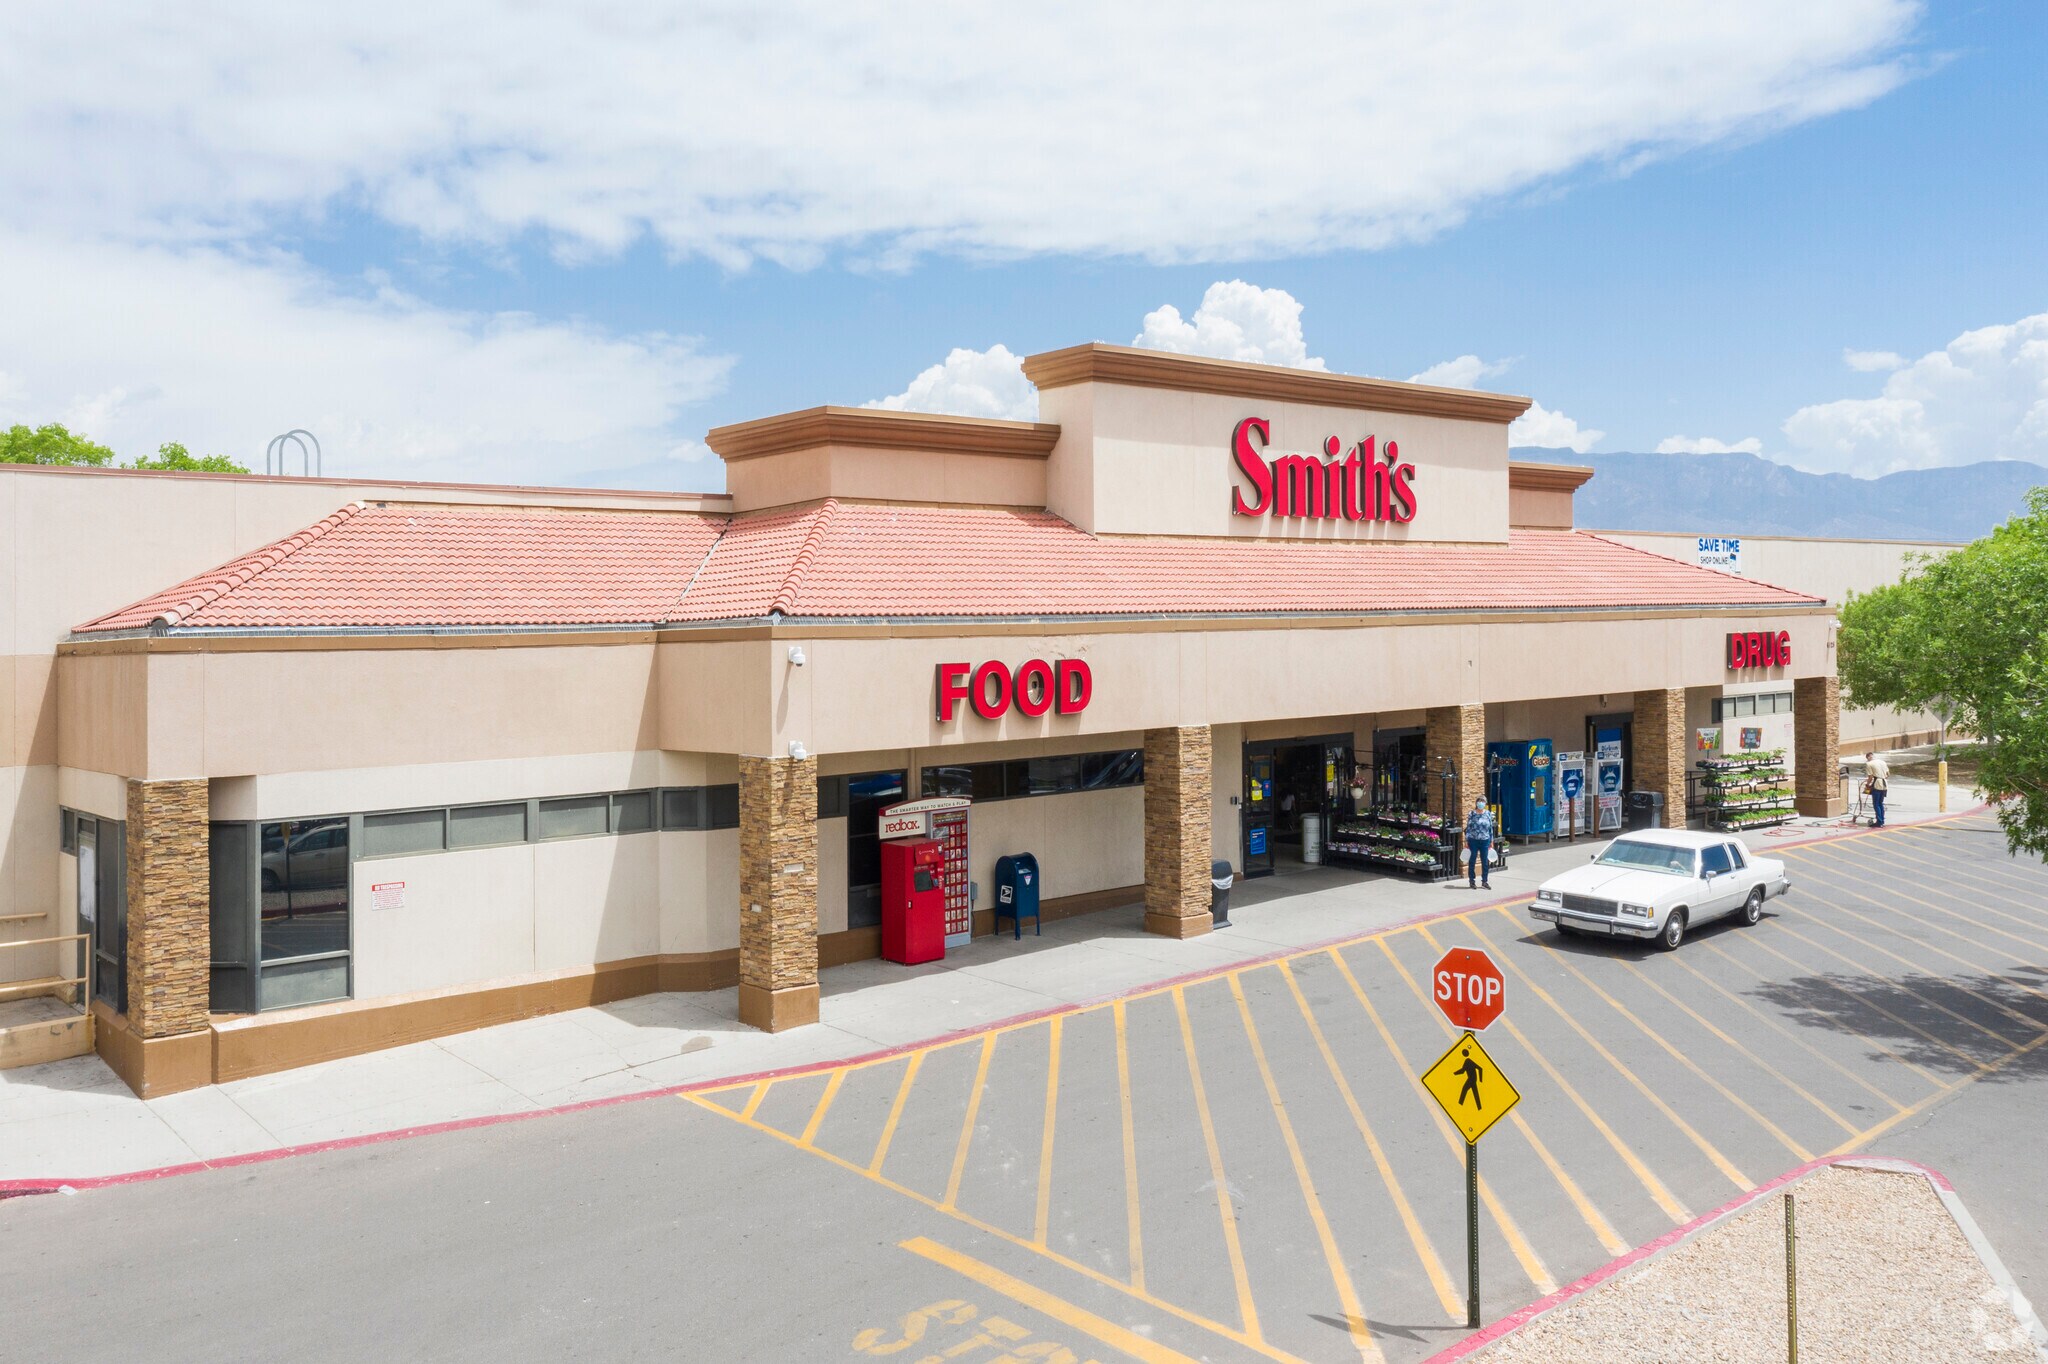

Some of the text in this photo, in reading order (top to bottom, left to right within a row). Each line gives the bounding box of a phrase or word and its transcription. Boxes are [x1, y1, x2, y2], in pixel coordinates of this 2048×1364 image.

[1232, 416, 1417, 523] Smith's
[1698, 538, 1740, 553] SAVE TIME
[1700, 556, 1711, 565] SHOP
[1727, 630, 1791, 669] DRUG
[936, 658, 1092, 722] FOOD
[1437, 970, 1501, 1007] STOP
